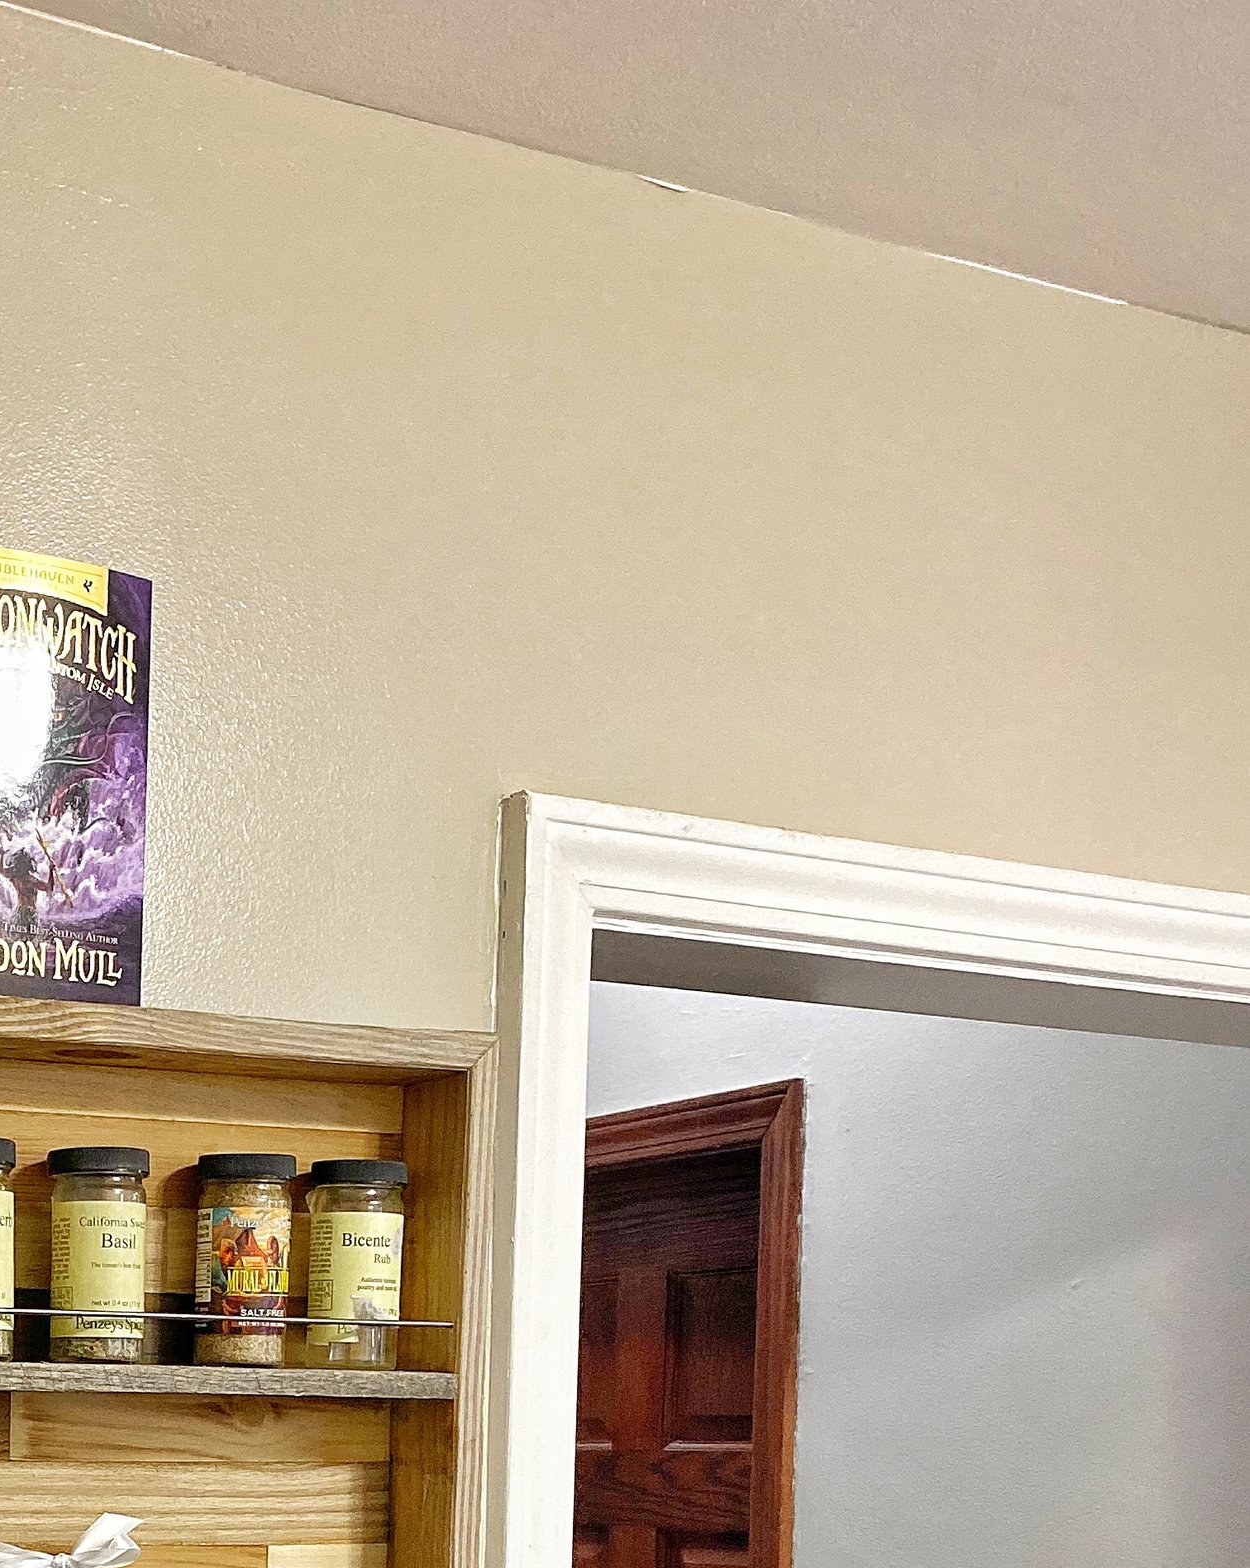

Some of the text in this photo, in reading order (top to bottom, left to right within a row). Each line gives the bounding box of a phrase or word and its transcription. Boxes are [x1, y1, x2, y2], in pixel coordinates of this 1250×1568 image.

[87, 670, 116, 700] ISLE
[2, 920, 29, 934] TIMES
[85, 930, 119, 945] AUTHOR
[52, 937, 123, 987] MULL
[79, 1216, 128, 1228] California
[101, 1233, 136, 1249] Basil
[374, 1254, 391, 1264] Rub
[227, 1269, 261, 1293] MURAL
[240, 1308, 285, 1317] SALT FREE
[75, 1315, 124, 1333] Penzeys
